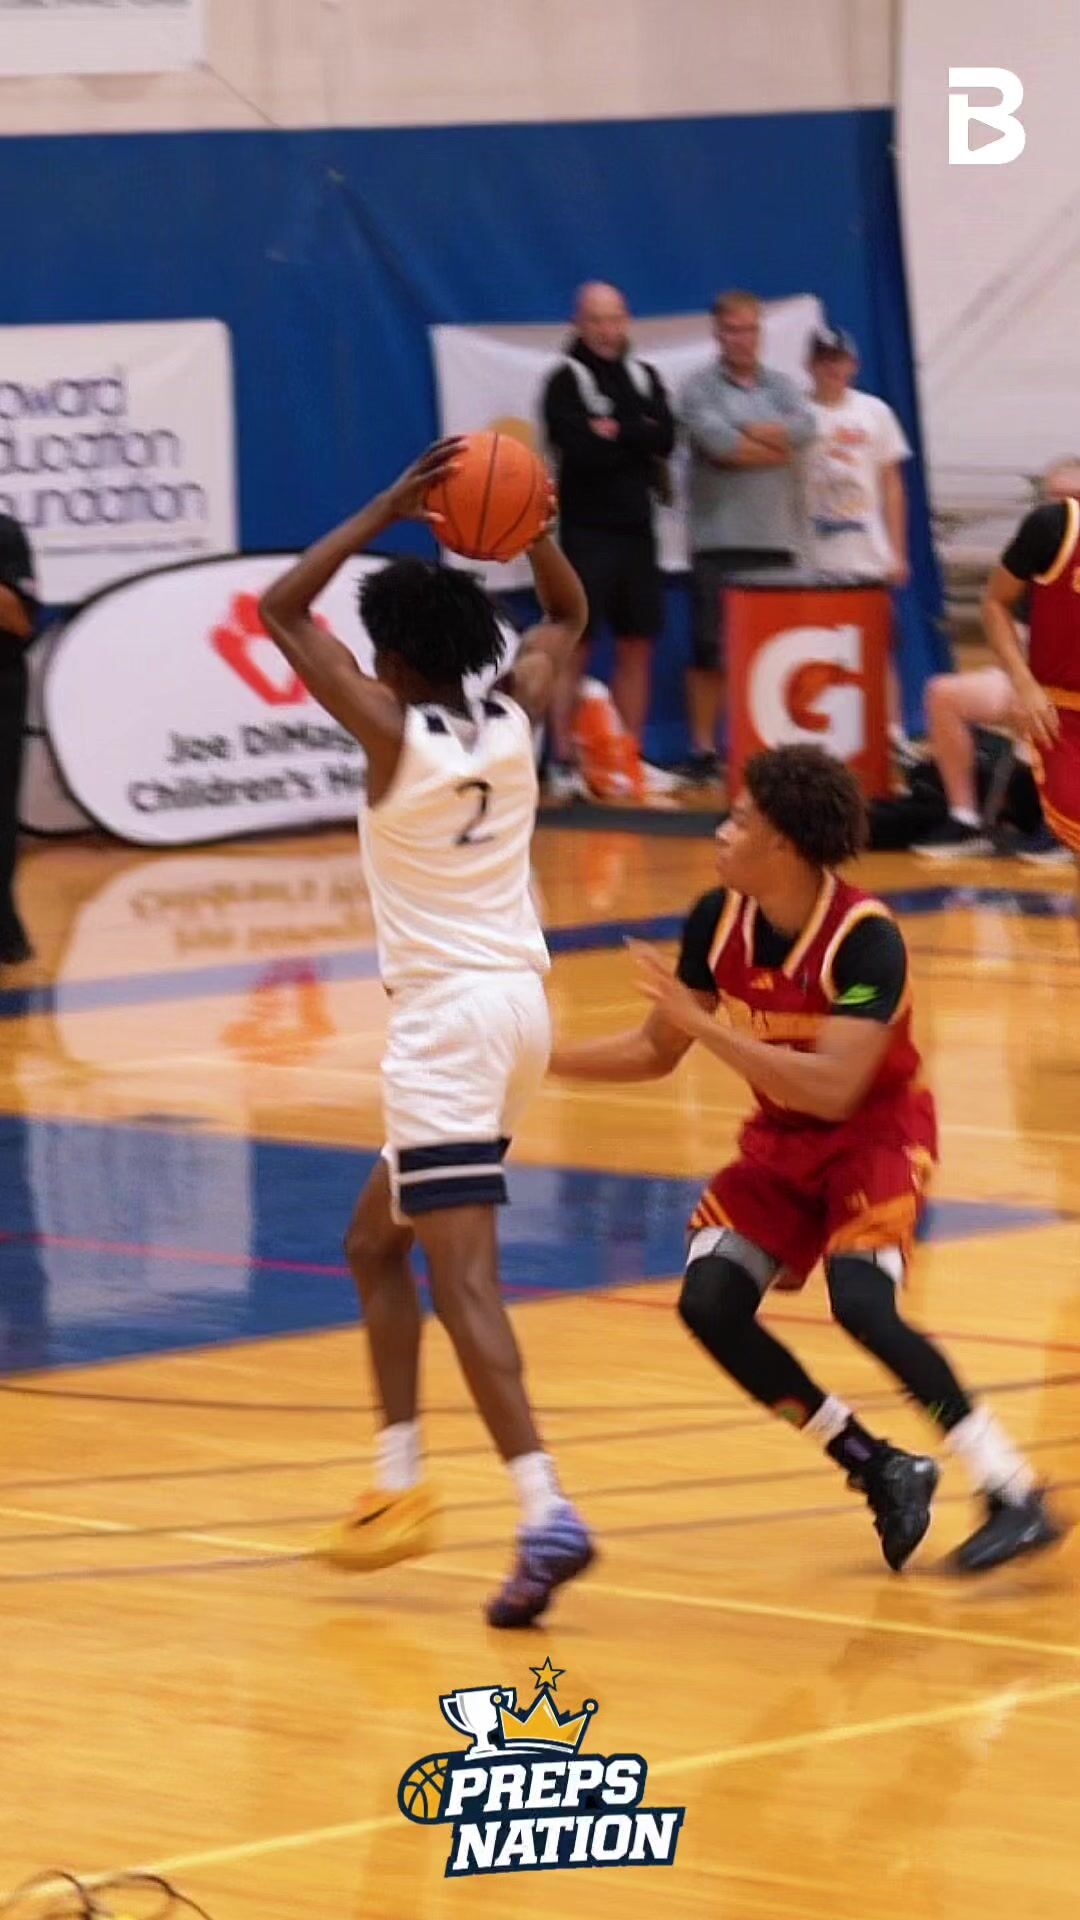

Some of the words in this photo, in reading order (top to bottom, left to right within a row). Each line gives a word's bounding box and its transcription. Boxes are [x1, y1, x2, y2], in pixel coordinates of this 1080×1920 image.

[748, 624, 865, 760] G
[167, 732, 230, 764] Joe
[454, 778, 496, 846] 2
